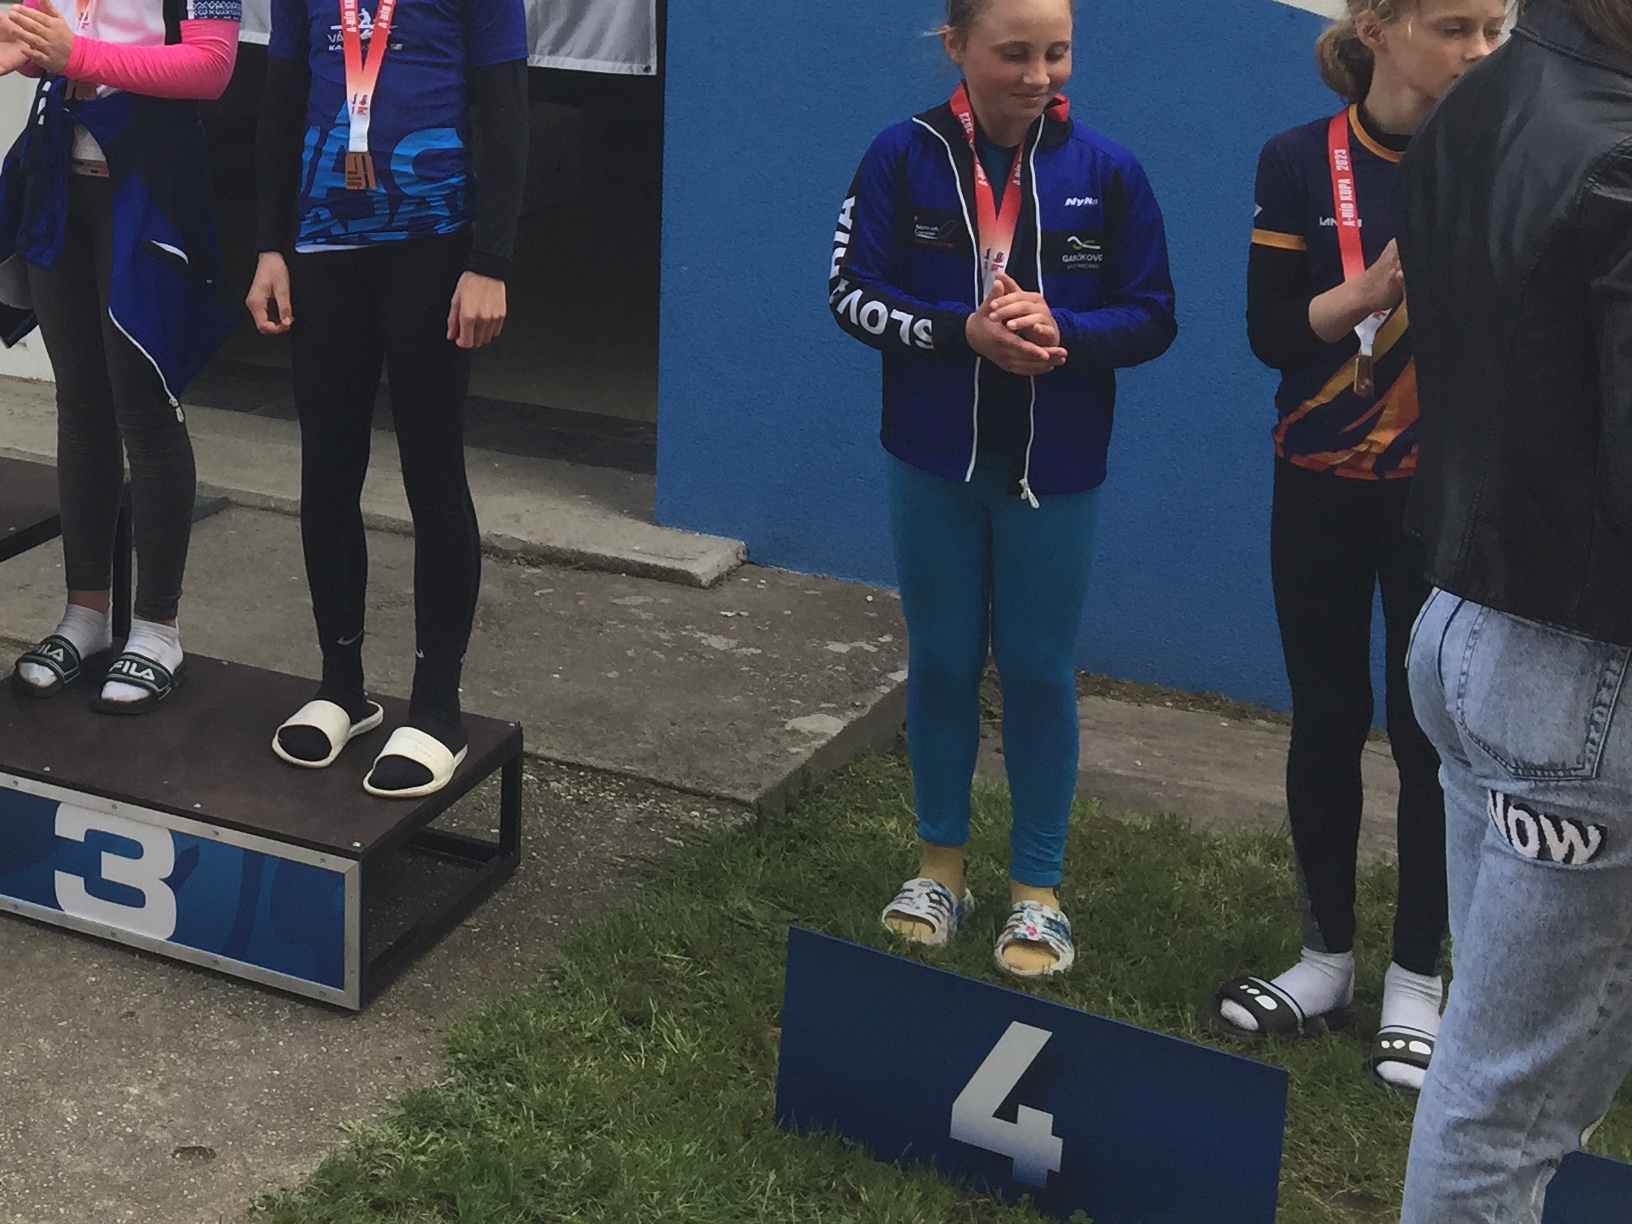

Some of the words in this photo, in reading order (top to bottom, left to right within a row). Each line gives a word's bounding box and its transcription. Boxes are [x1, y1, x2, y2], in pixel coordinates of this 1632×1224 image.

[1334, 148, 1349, 171] 2023
[109, 661, 156, 681] FILA
[53, 800, 178, 942] 3
[950, 1020, 1064, 1189] 4
